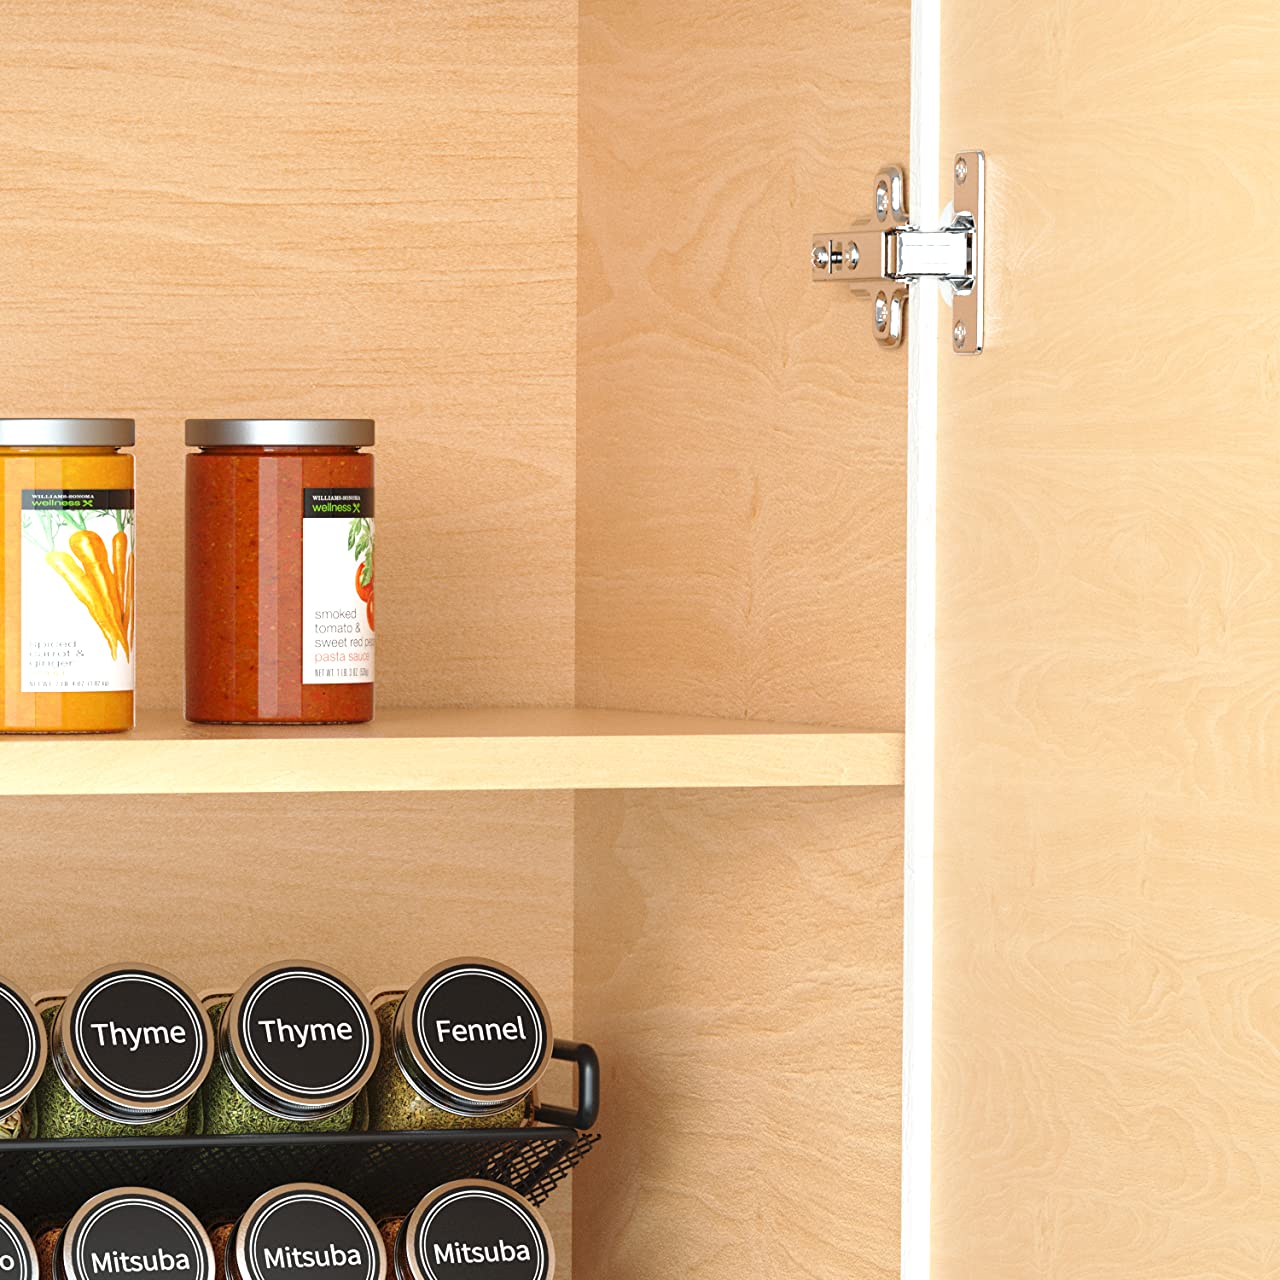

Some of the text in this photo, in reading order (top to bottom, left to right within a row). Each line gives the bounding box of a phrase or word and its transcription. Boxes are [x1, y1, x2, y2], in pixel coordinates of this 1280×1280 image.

[312, 502, 352, 512] wellness
[314, 608, 357, 620] smoked
[314, 622, 361, 634] tomato &
[314, 637, 348, 648] sweet
[350, 637, 363, 648] red
[314, 651, 369, 664] pasta sauce
[314, 668, 325, 677] NET
[90, 1021, 186, 1052] Thyme
[257, 1018, 353, 1048] Thyme
[436, 1015, 527, 1043] Fennel
[91, 1247, 191, 1274] Mitsuba
[263, 1243, 362, 1269] Mitsuba
[433, 1239, 531, 1265] Mitsuba
